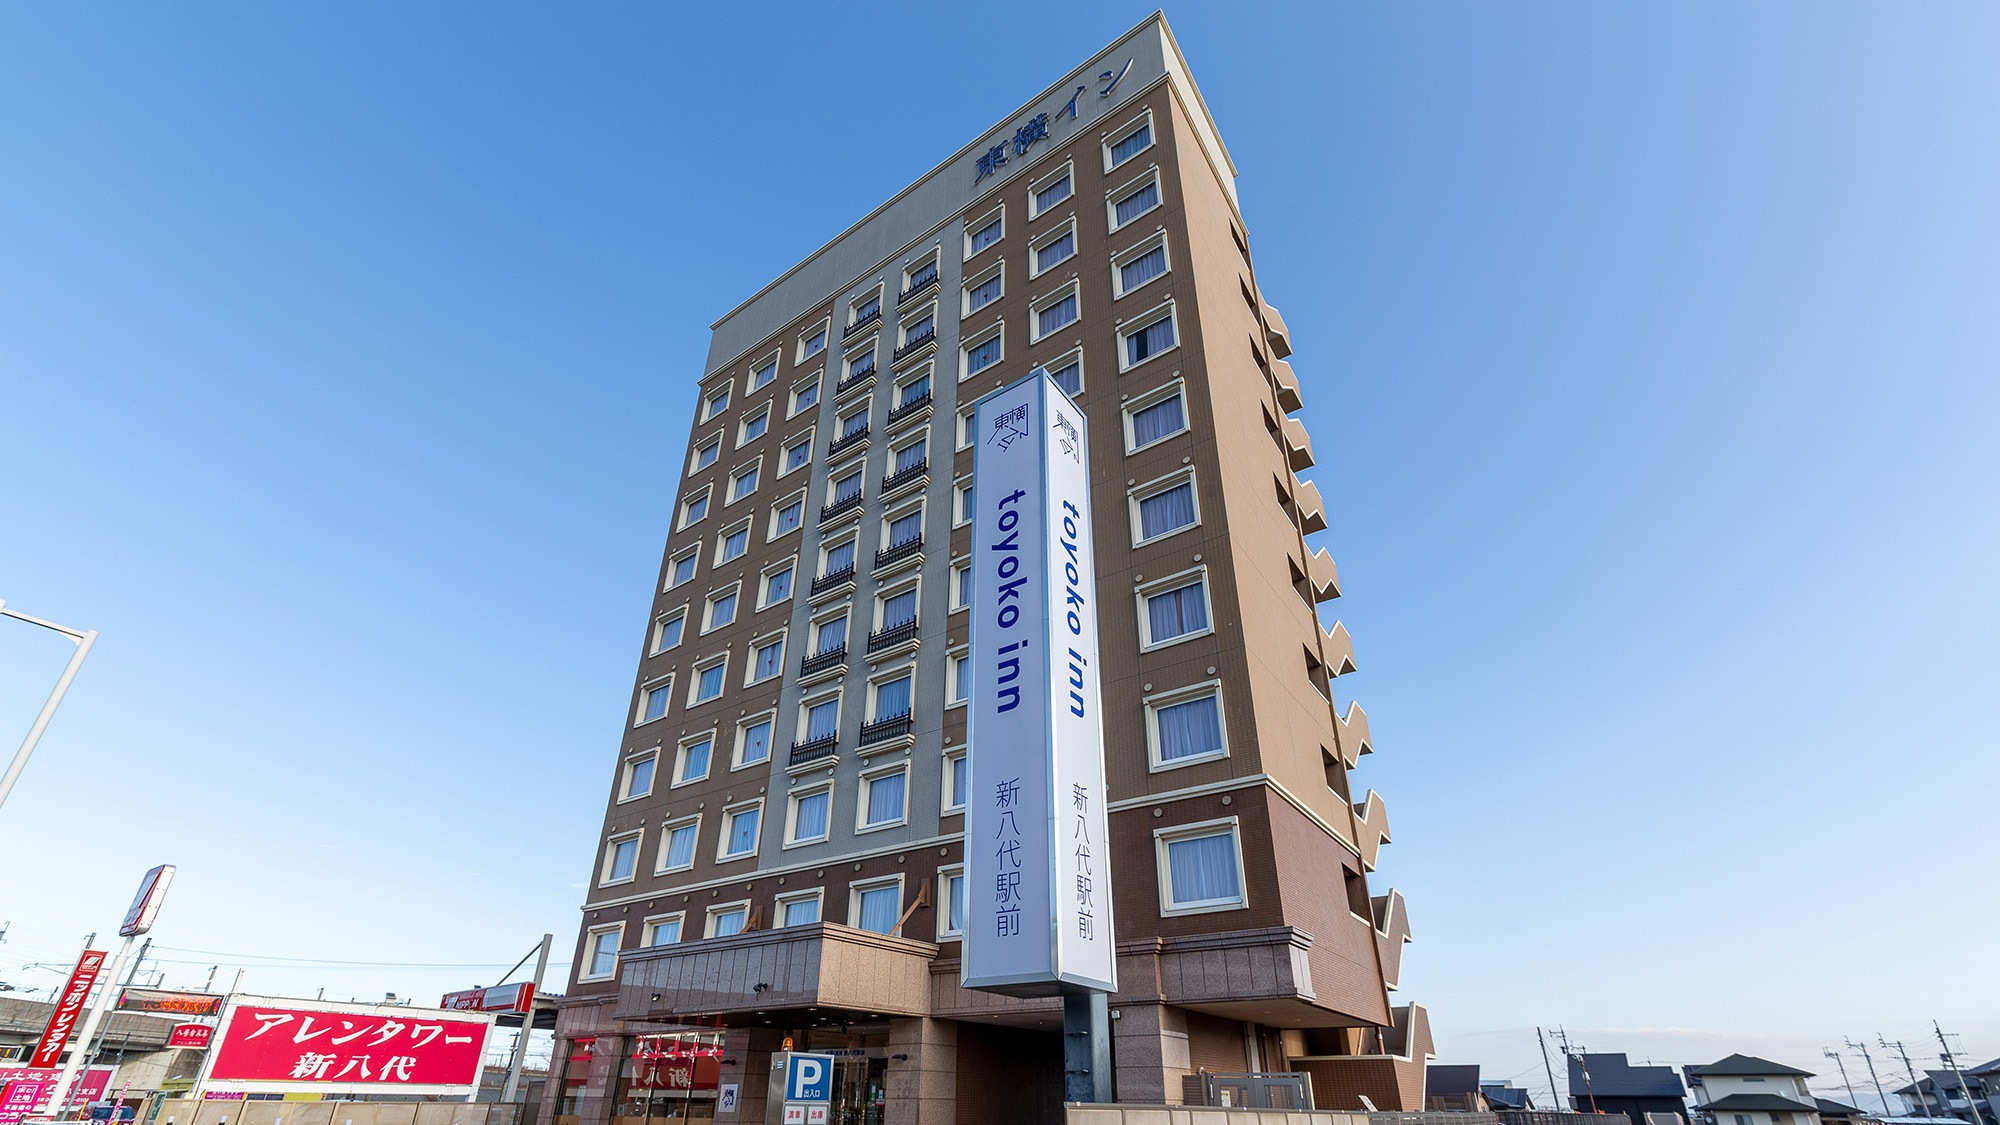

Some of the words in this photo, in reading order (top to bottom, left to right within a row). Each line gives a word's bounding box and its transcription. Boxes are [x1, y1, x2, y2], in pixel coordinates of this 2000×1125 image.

[975, 58, 1133, 184] 東横イン
[991, 489, 1028, 629] toyoko
[1060, 500, 1085, 636] toyoko
[997, 639, 1029, 714] inn
[1068, 647, 1088, 719] inn
[995, 777, 1022, 938] 新八代駅前
[1072, 782, 1094, 941] 新八代駅前
[41, 974, 93, 1062] ニッポンレンタカー
[244, 1012, 473, 1049] アレンタワー
[288, 1051, 417, 1081] 新八代
[795, 1059, 822, 1098] P
[803, 1089, 820, 1098] 出入口
